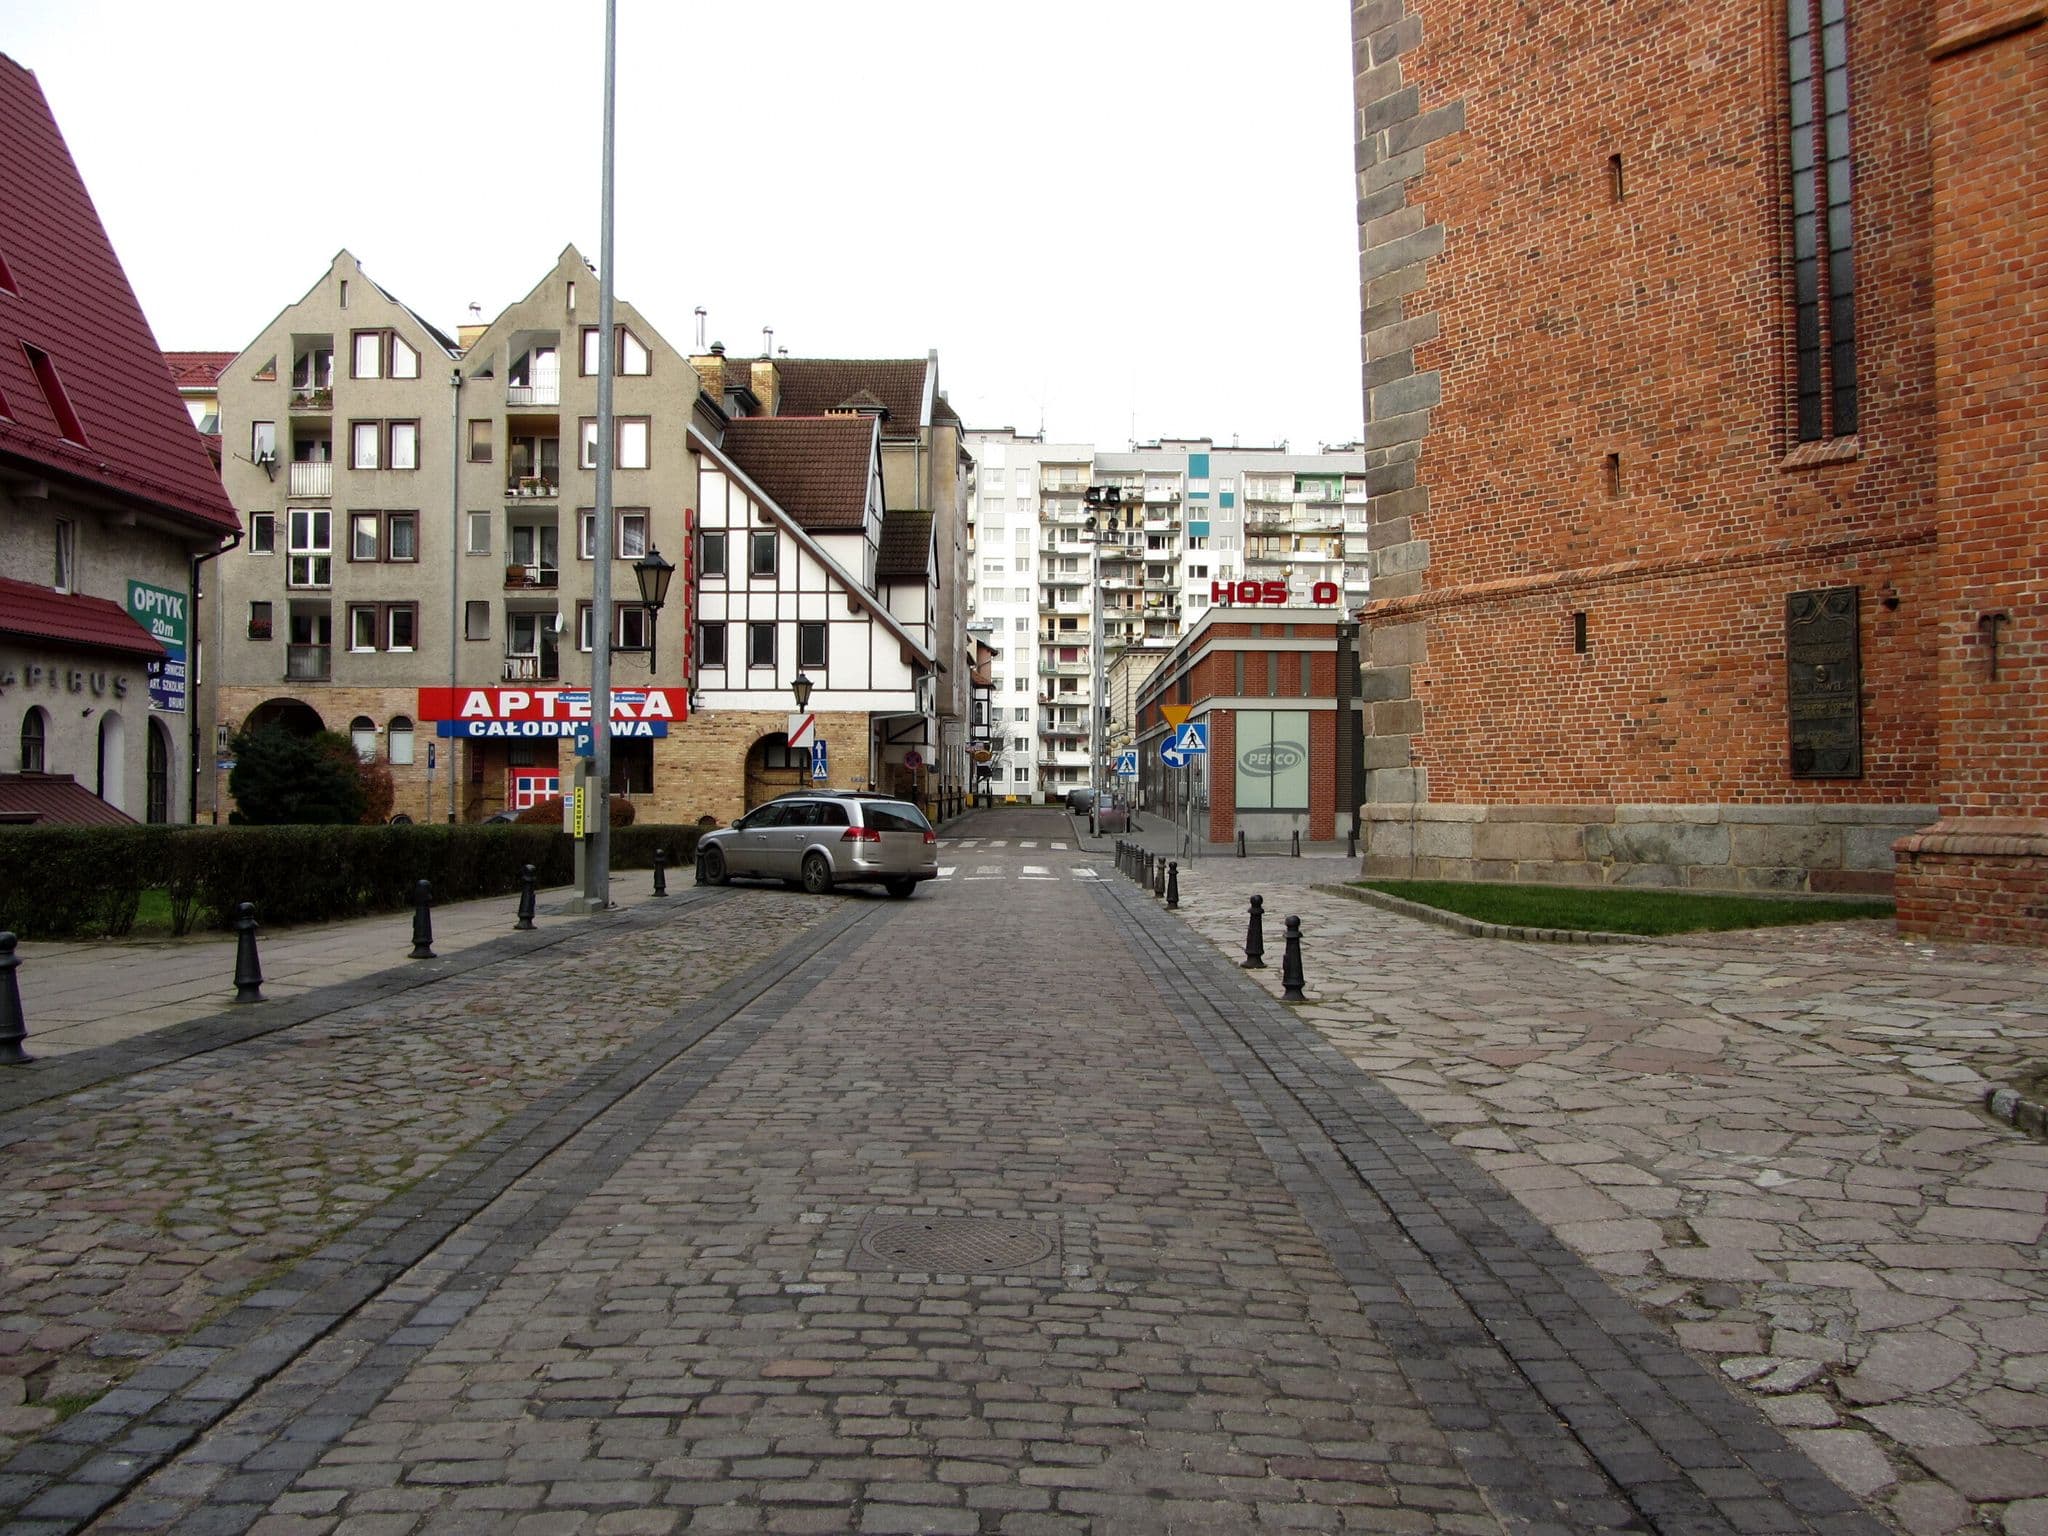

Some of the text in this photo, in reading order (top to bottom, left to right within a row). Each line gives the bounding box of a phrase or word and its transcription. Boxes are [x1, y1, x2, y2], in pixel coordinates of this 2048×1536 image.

[1211, 574, 1338, 604] HOSSO
[134, 586, 183, 620] OPTYK
[577, 735, 590, 748] P
[1248, 753, 1297, 766] PEPCO
